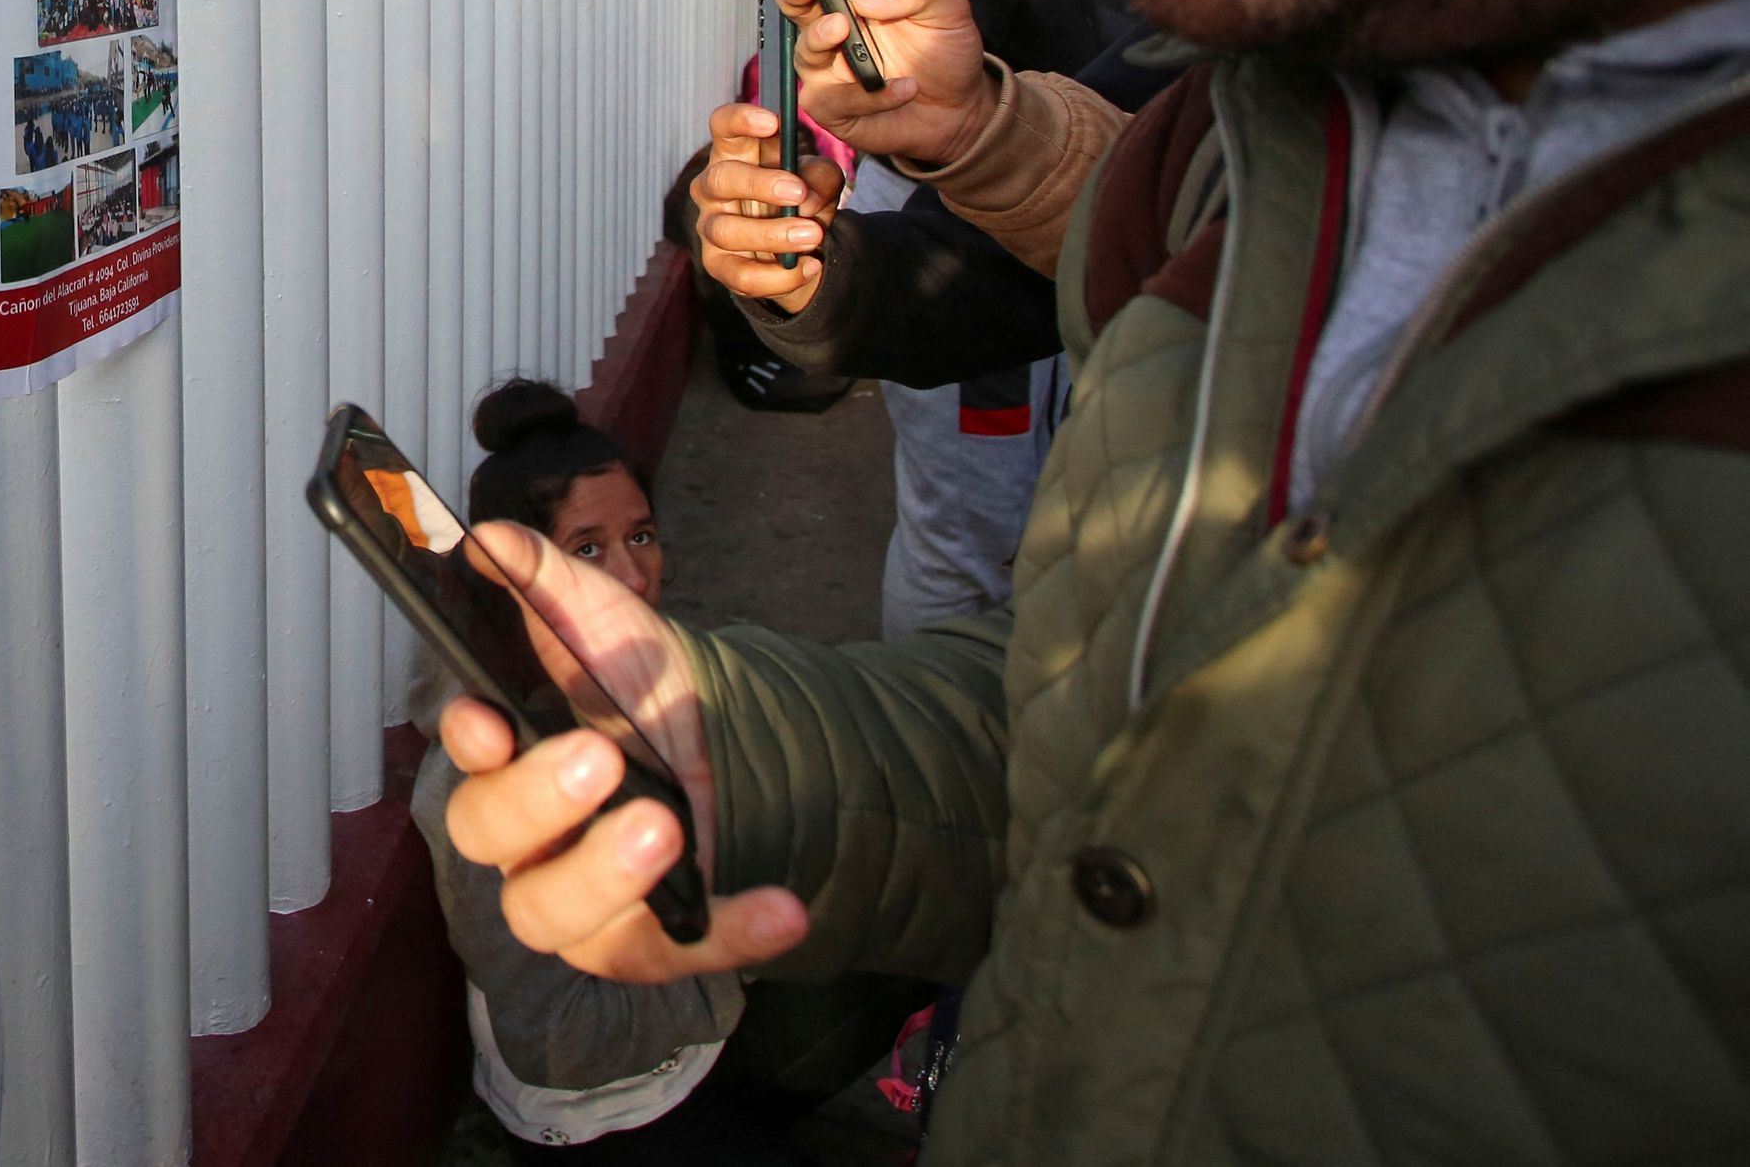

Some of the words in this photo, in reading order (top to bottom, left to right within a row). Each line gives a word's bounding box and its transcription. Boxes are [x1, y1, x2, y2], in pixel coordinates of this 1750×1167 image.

[0, 297, 41, 316] Cañon
[42, 287, 56, 306] del
[57, 275, 87, 299] Alacran
[88, 269, 94, 285] #
[95, 265, 114, 284] 4094
[132, 247, 152, 265] Divina
[99, 284, 117, 302] Baja
[117, 267, 150, 293] California
[99, 295, 140, 324] 6641723591
